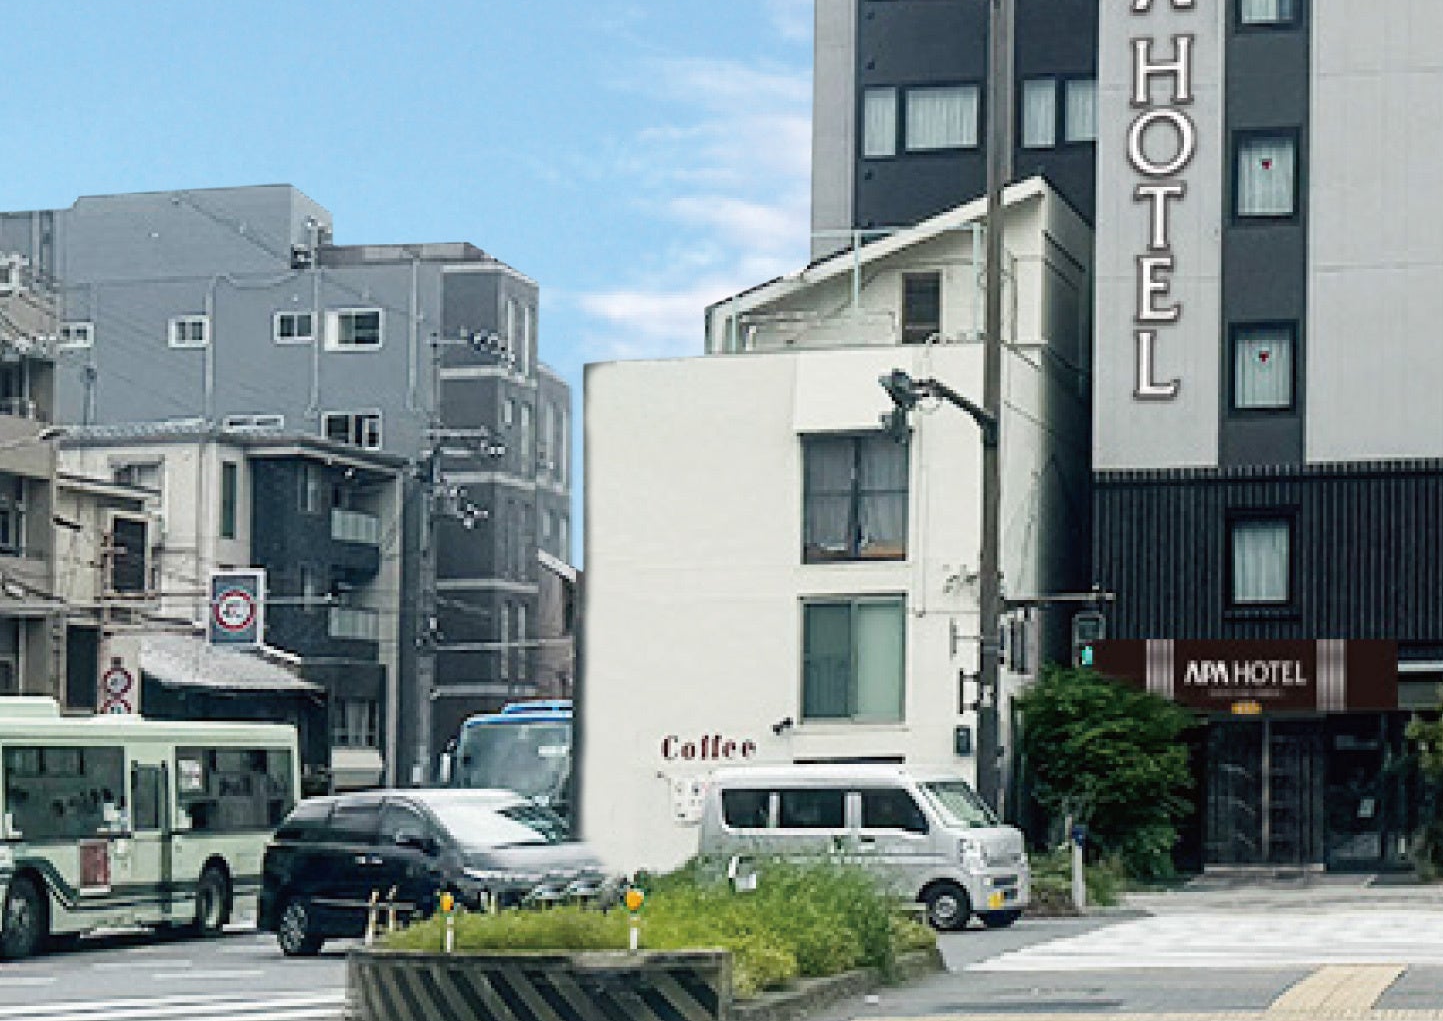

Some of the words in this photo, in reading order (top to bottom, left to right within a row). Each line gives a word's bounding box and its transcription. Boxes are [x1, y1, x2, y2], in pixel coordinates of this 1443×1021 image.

[1127, 35, 1197, 400] HOTEL
[1184, 660, 1229, 686] APA
[1233, 660, 1307, 686] HOTEL
[661, 735, 756, 761] Coffee
